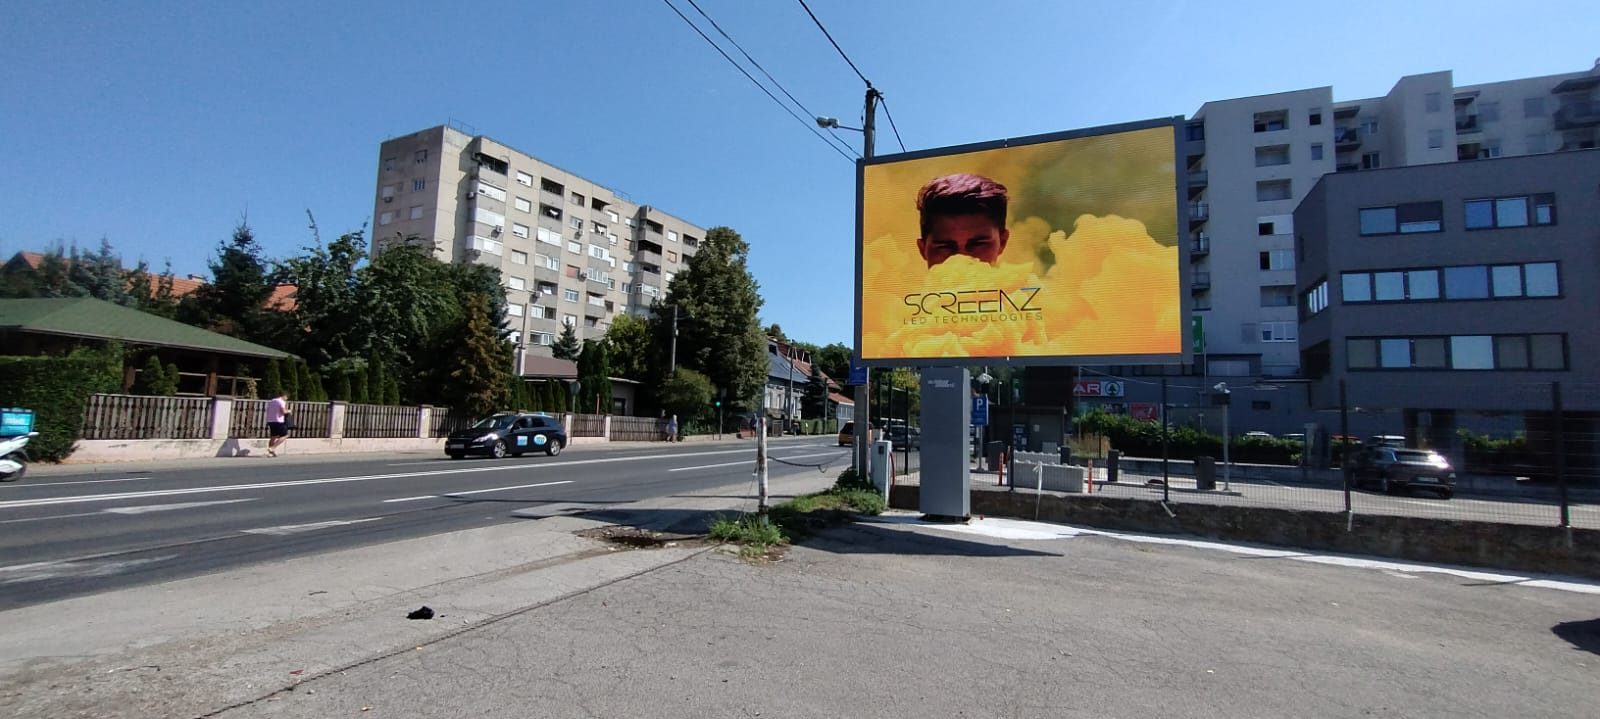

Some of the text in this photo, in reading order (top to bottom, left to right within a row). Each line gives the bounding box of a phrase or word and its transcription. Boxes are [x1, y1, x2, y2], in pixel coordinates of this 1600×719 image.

[904, 287, 1042, 315] SCREENZ
[903, 312, 1043, 325] LED TECHNOLOGIES
[1073, 383, 1100, 393] AR
[976, 398, 984, 411] P
